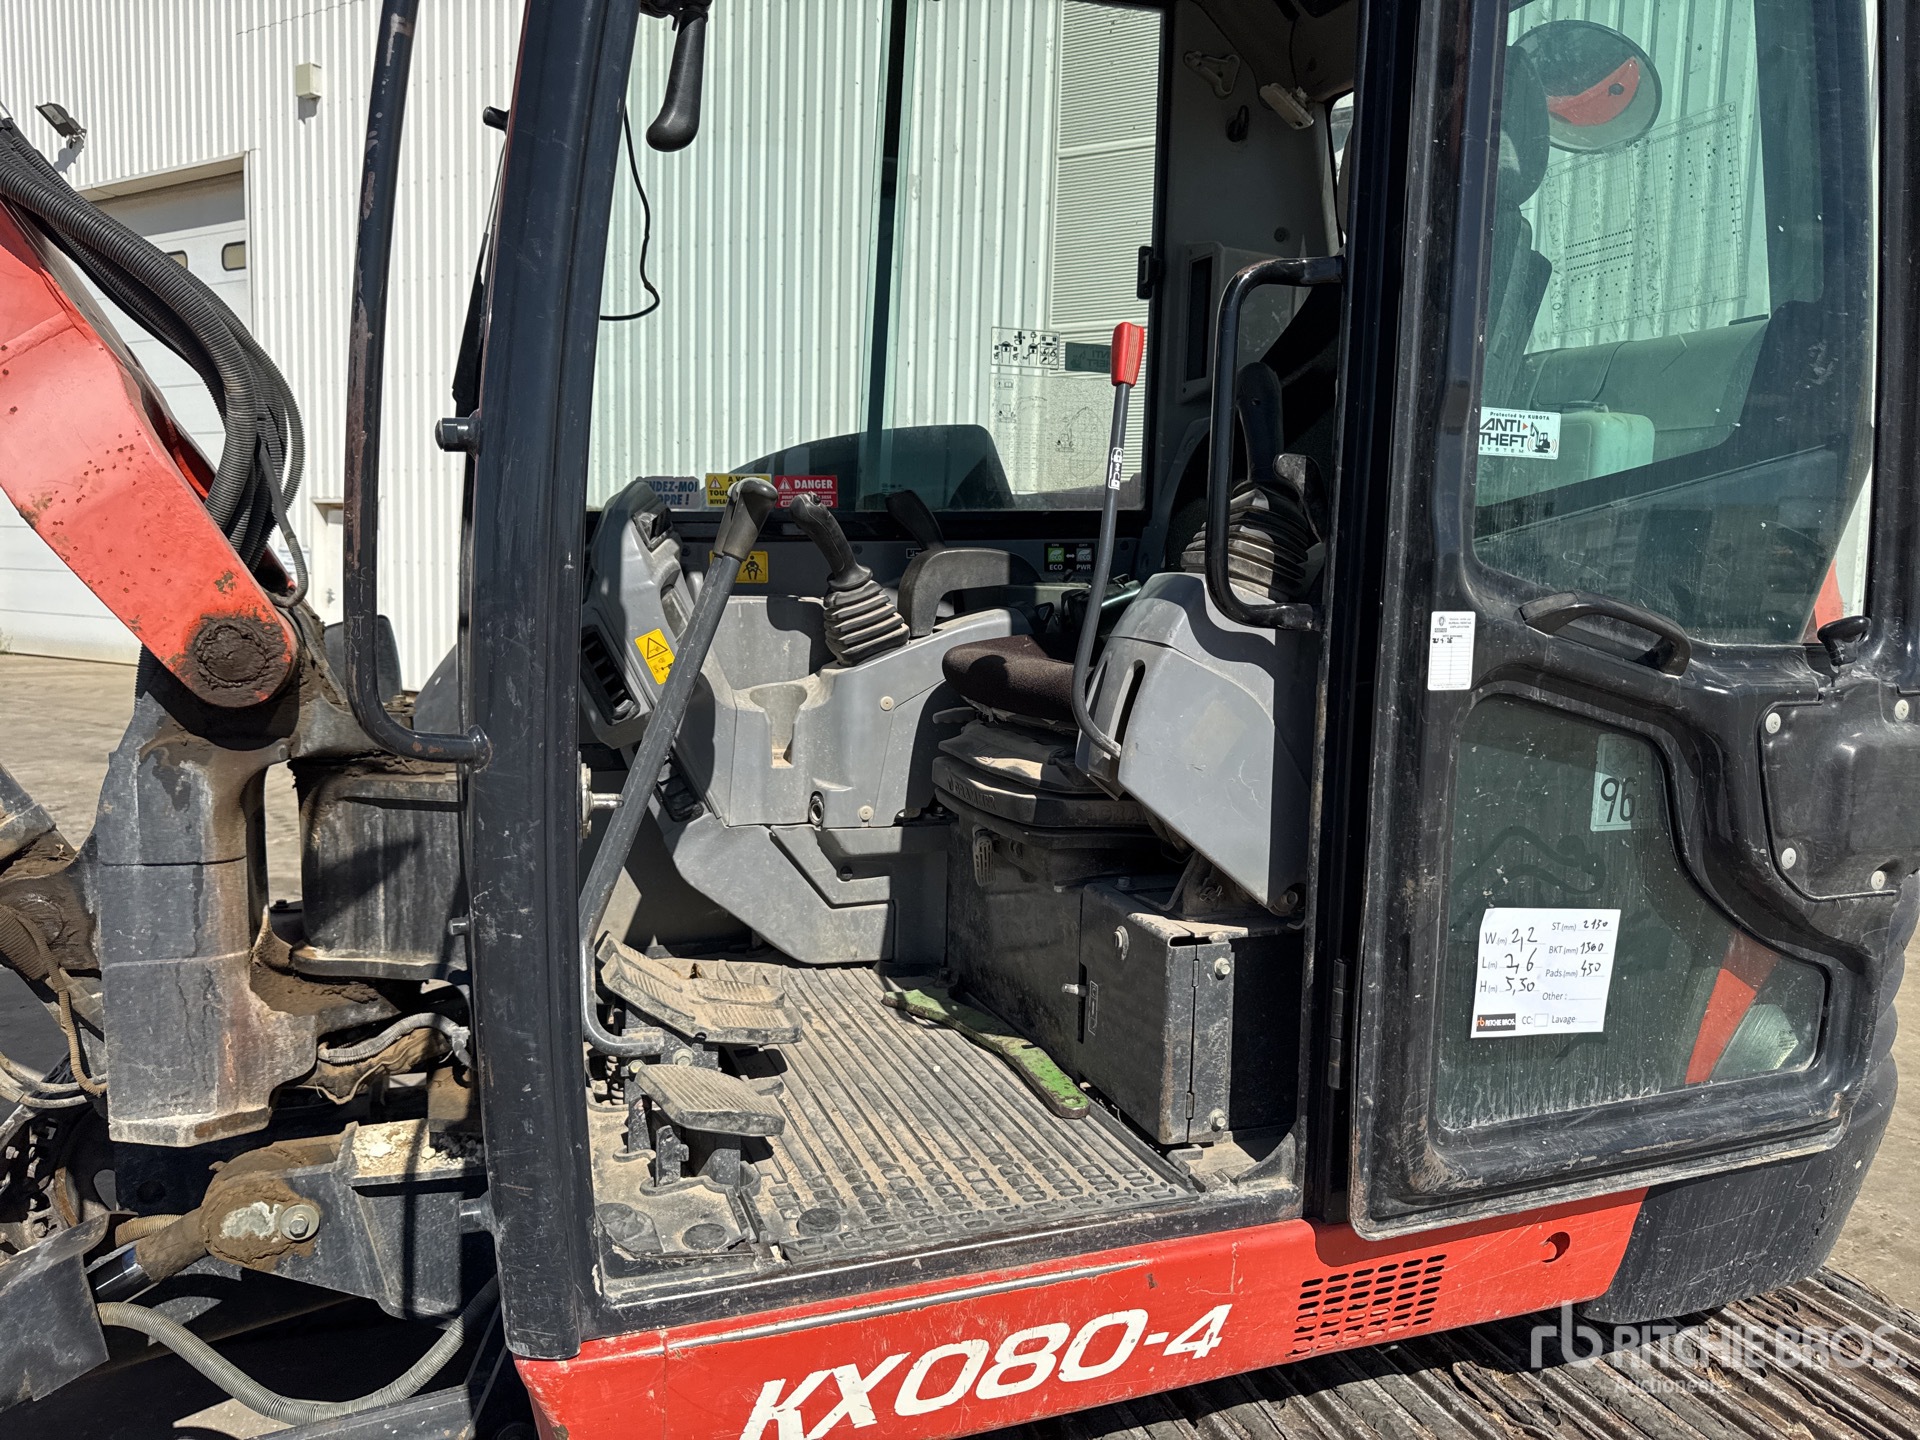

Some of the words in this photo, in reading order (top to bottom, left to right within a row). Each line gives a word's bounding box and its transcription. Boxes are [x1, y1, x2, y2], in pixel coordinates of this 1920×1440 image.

[1490, 411, 1517, 419] Protected
[1480, 418, 1521, 432] ANTI
[1479, 432, 1528, 447] THEFT
[794, 479, 833, 489] DANGER
[1600, 776, 1638, 823] 96
[739, 1303, 1233, 1440] KX080-4
